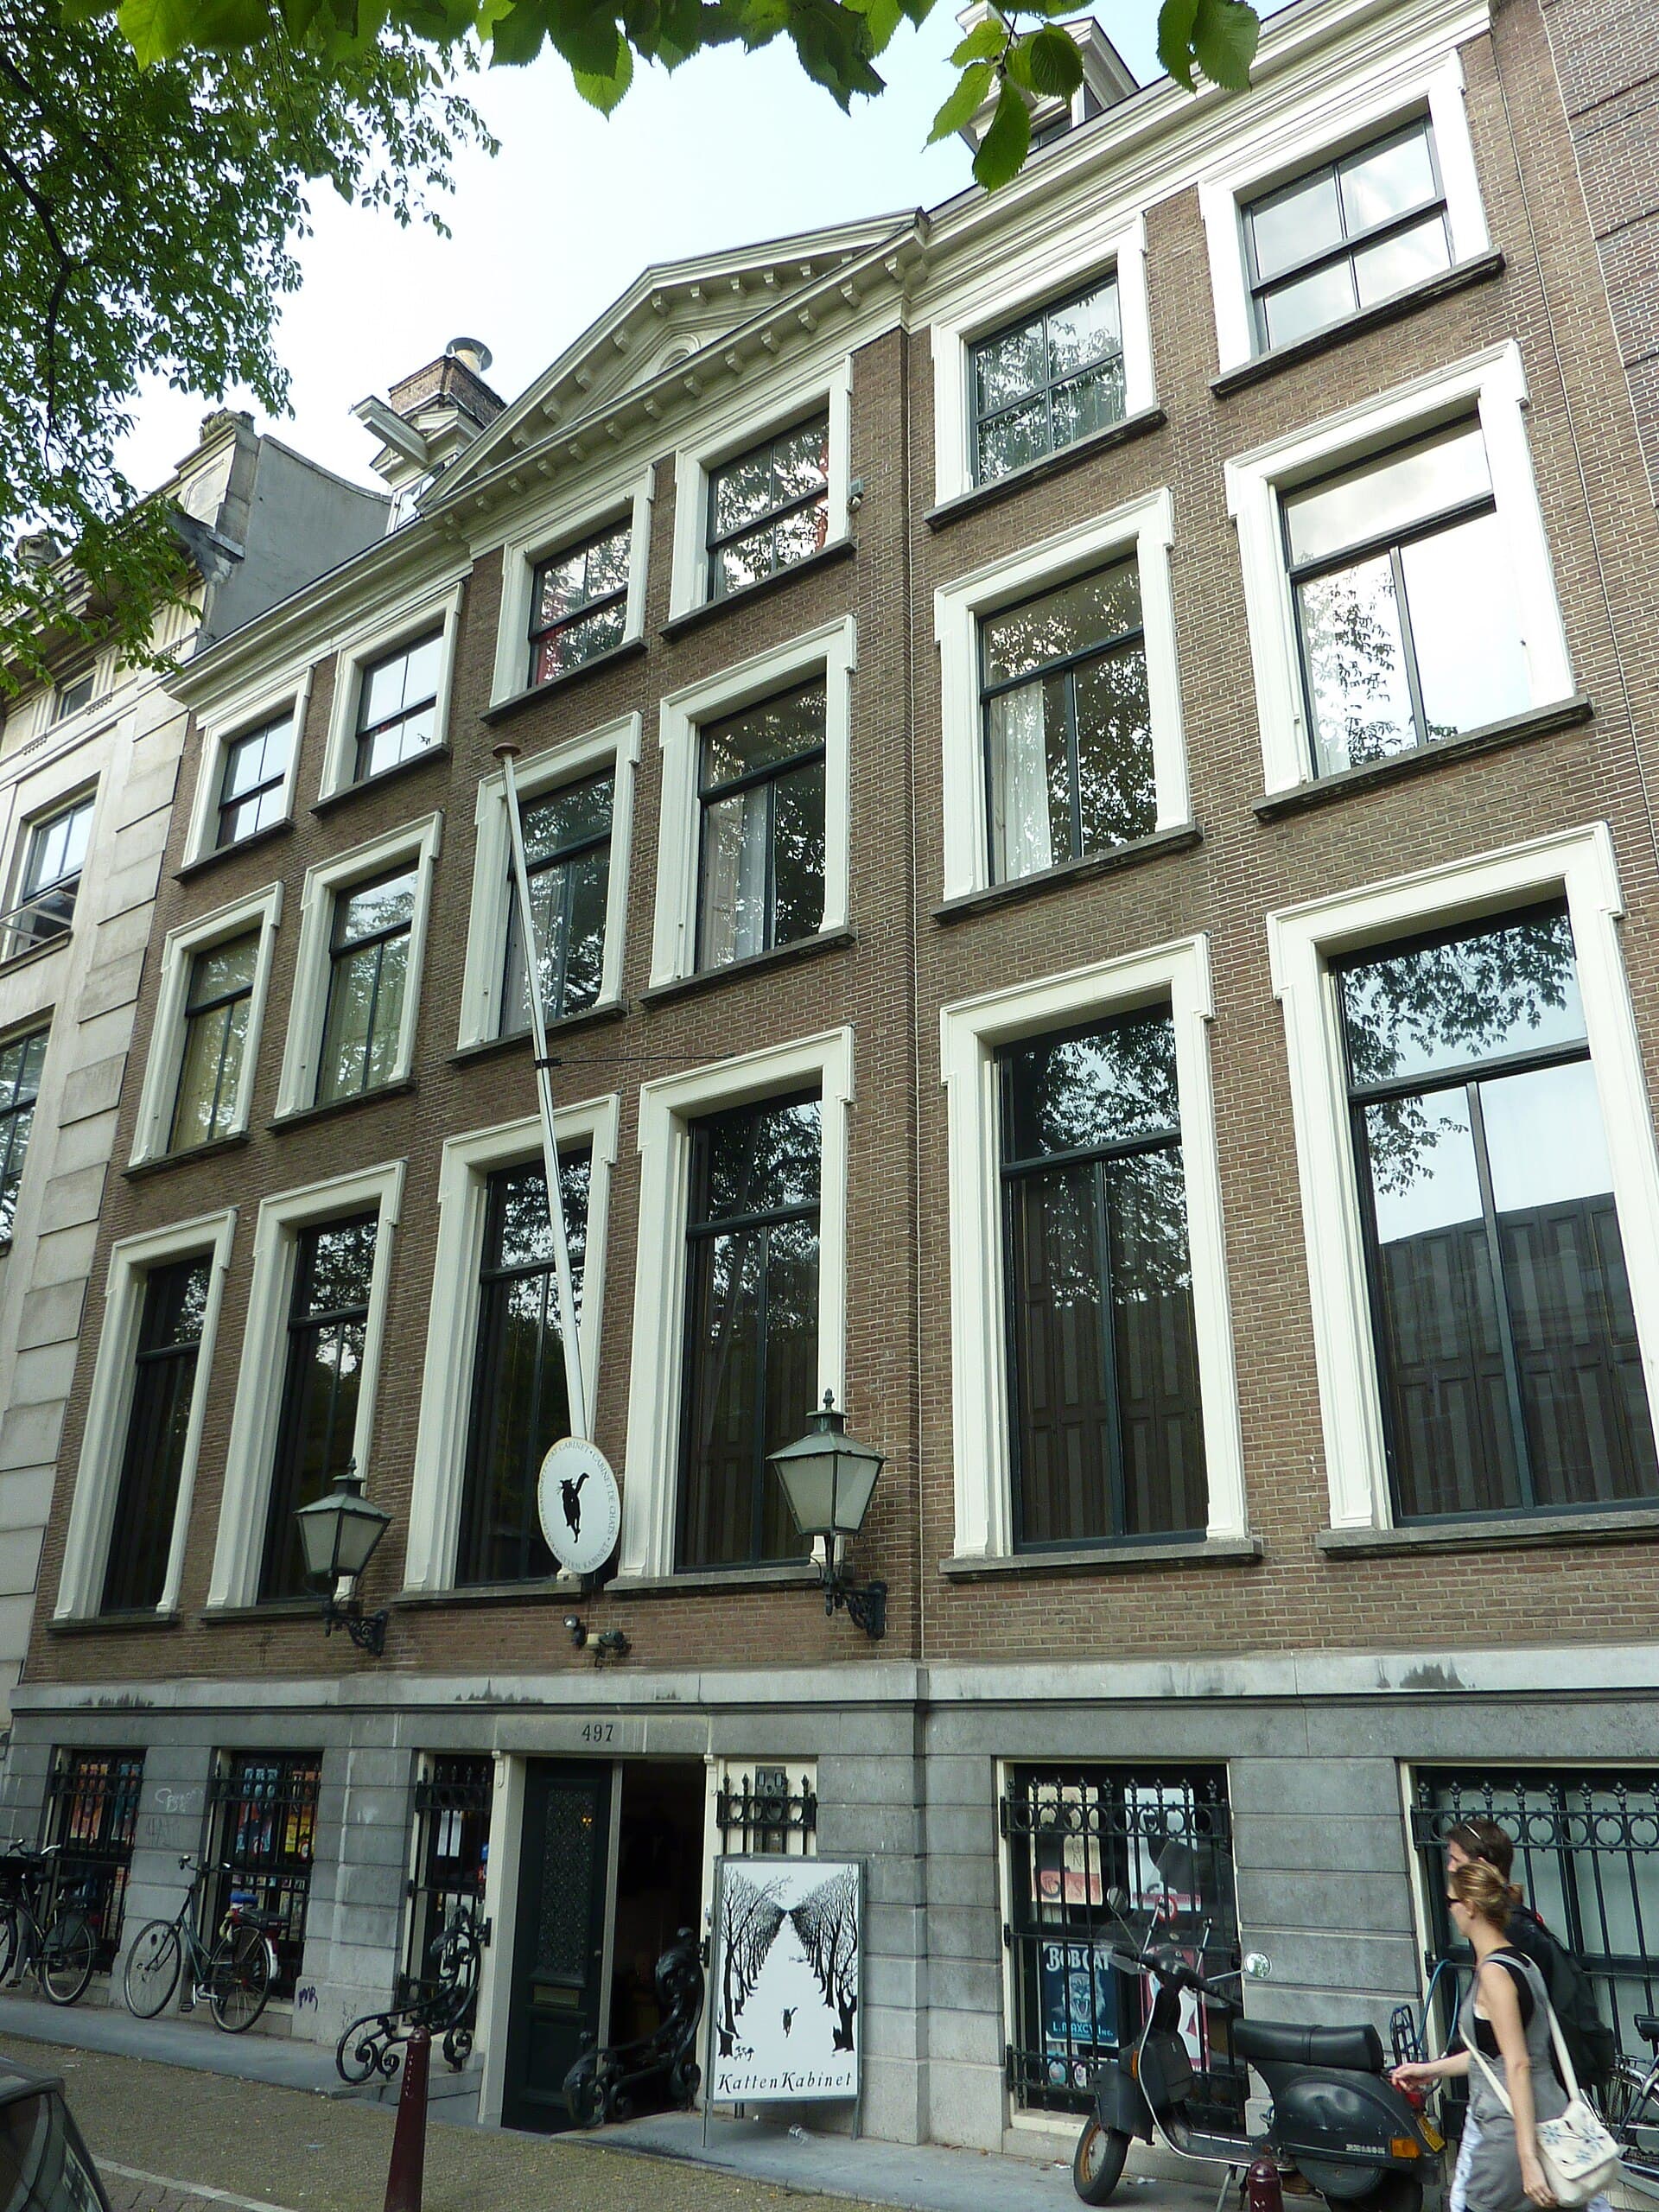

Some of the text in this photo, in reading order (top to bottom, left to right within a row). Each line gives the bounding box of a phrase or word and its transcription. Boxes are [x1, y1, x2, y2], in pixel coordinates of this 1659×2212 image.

[559, 1441, 589, 1453] CABINET
[592, 1453, 616, 1535] CABINET DE CHATS
[582, 1724, 613, 1742] 497
